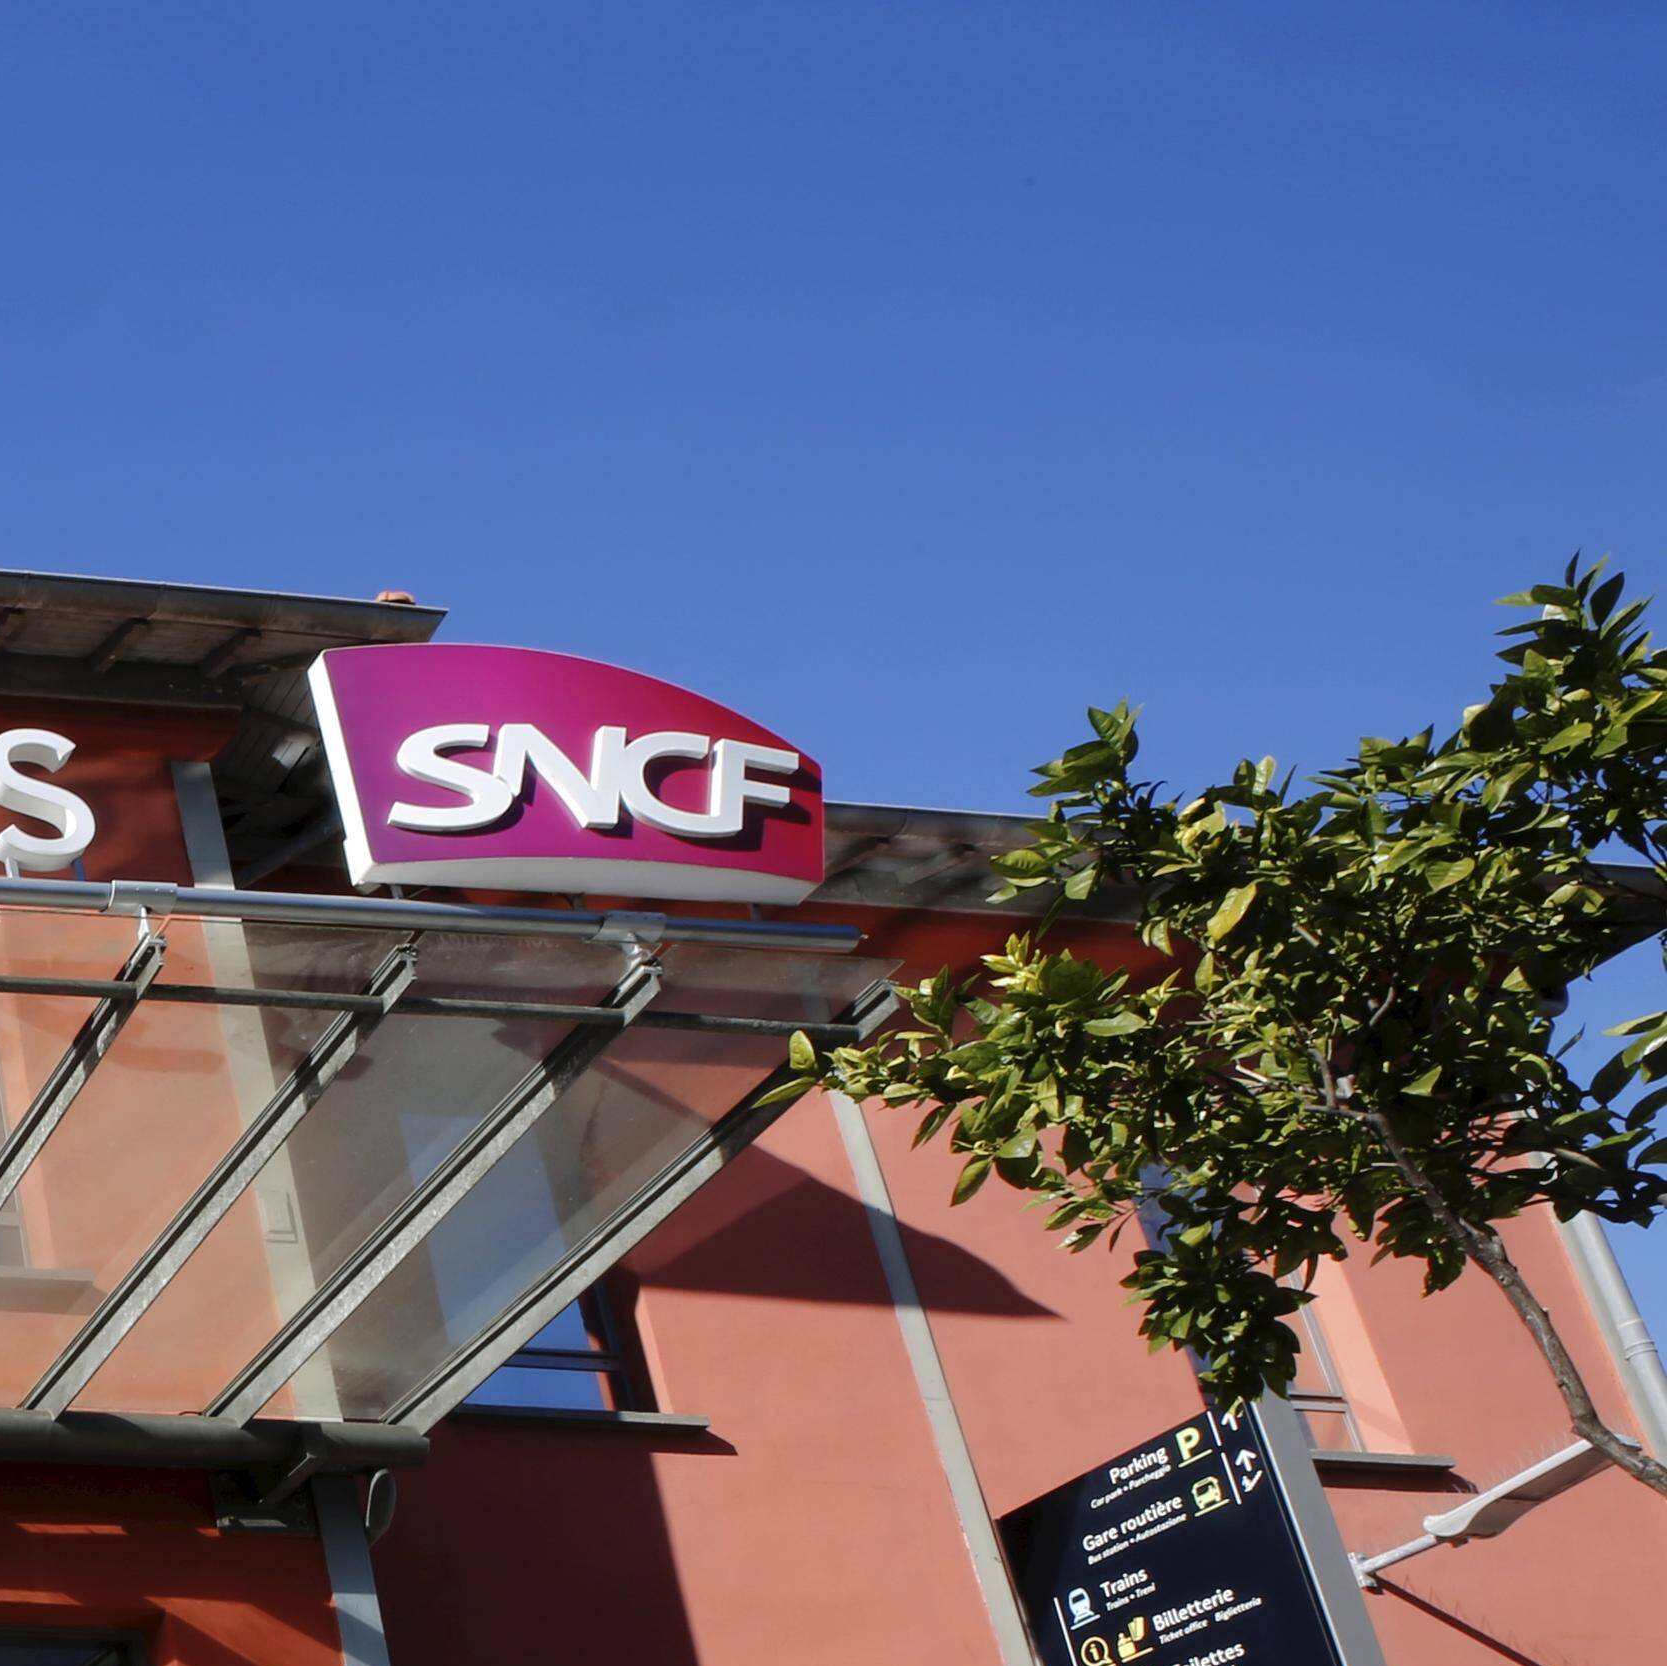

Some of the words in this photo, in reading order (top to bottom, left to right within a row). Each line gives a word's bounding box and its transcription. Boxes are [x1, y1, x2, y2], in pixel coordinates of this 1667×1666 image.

[386, 722, 801, 839] SNCF
[1090, 1497, 1105, 1509] Car
[1105, 1487, 1123, 1504] park
[1128, 1464, 1171, 1491] Parcheggio
[1109, 1447, 1168, 1484] Parking
[1082, 1527, 1119, 1552] Gare
[1120, 1496, 1183, 1534] routière
[1088, 1553, 1102, 1565] Bus
[1102, 1540, 1130, 1559] station
[1135, 1513, 1187, 1543] Autostazione
[1099, 1569, 1148, 1598] Trains
[1105, 1597, 1130, 1611] Trains
[1135, 1583, 1156, 1598] Treni
[1152, 1588, 1235, 1632] Billetterie
[1159, 1628, 1184, 1644] Ticket
[1184, 1619, 1209, 1635] office
[1214, 1597, 1262, 1622] Biglietteria
